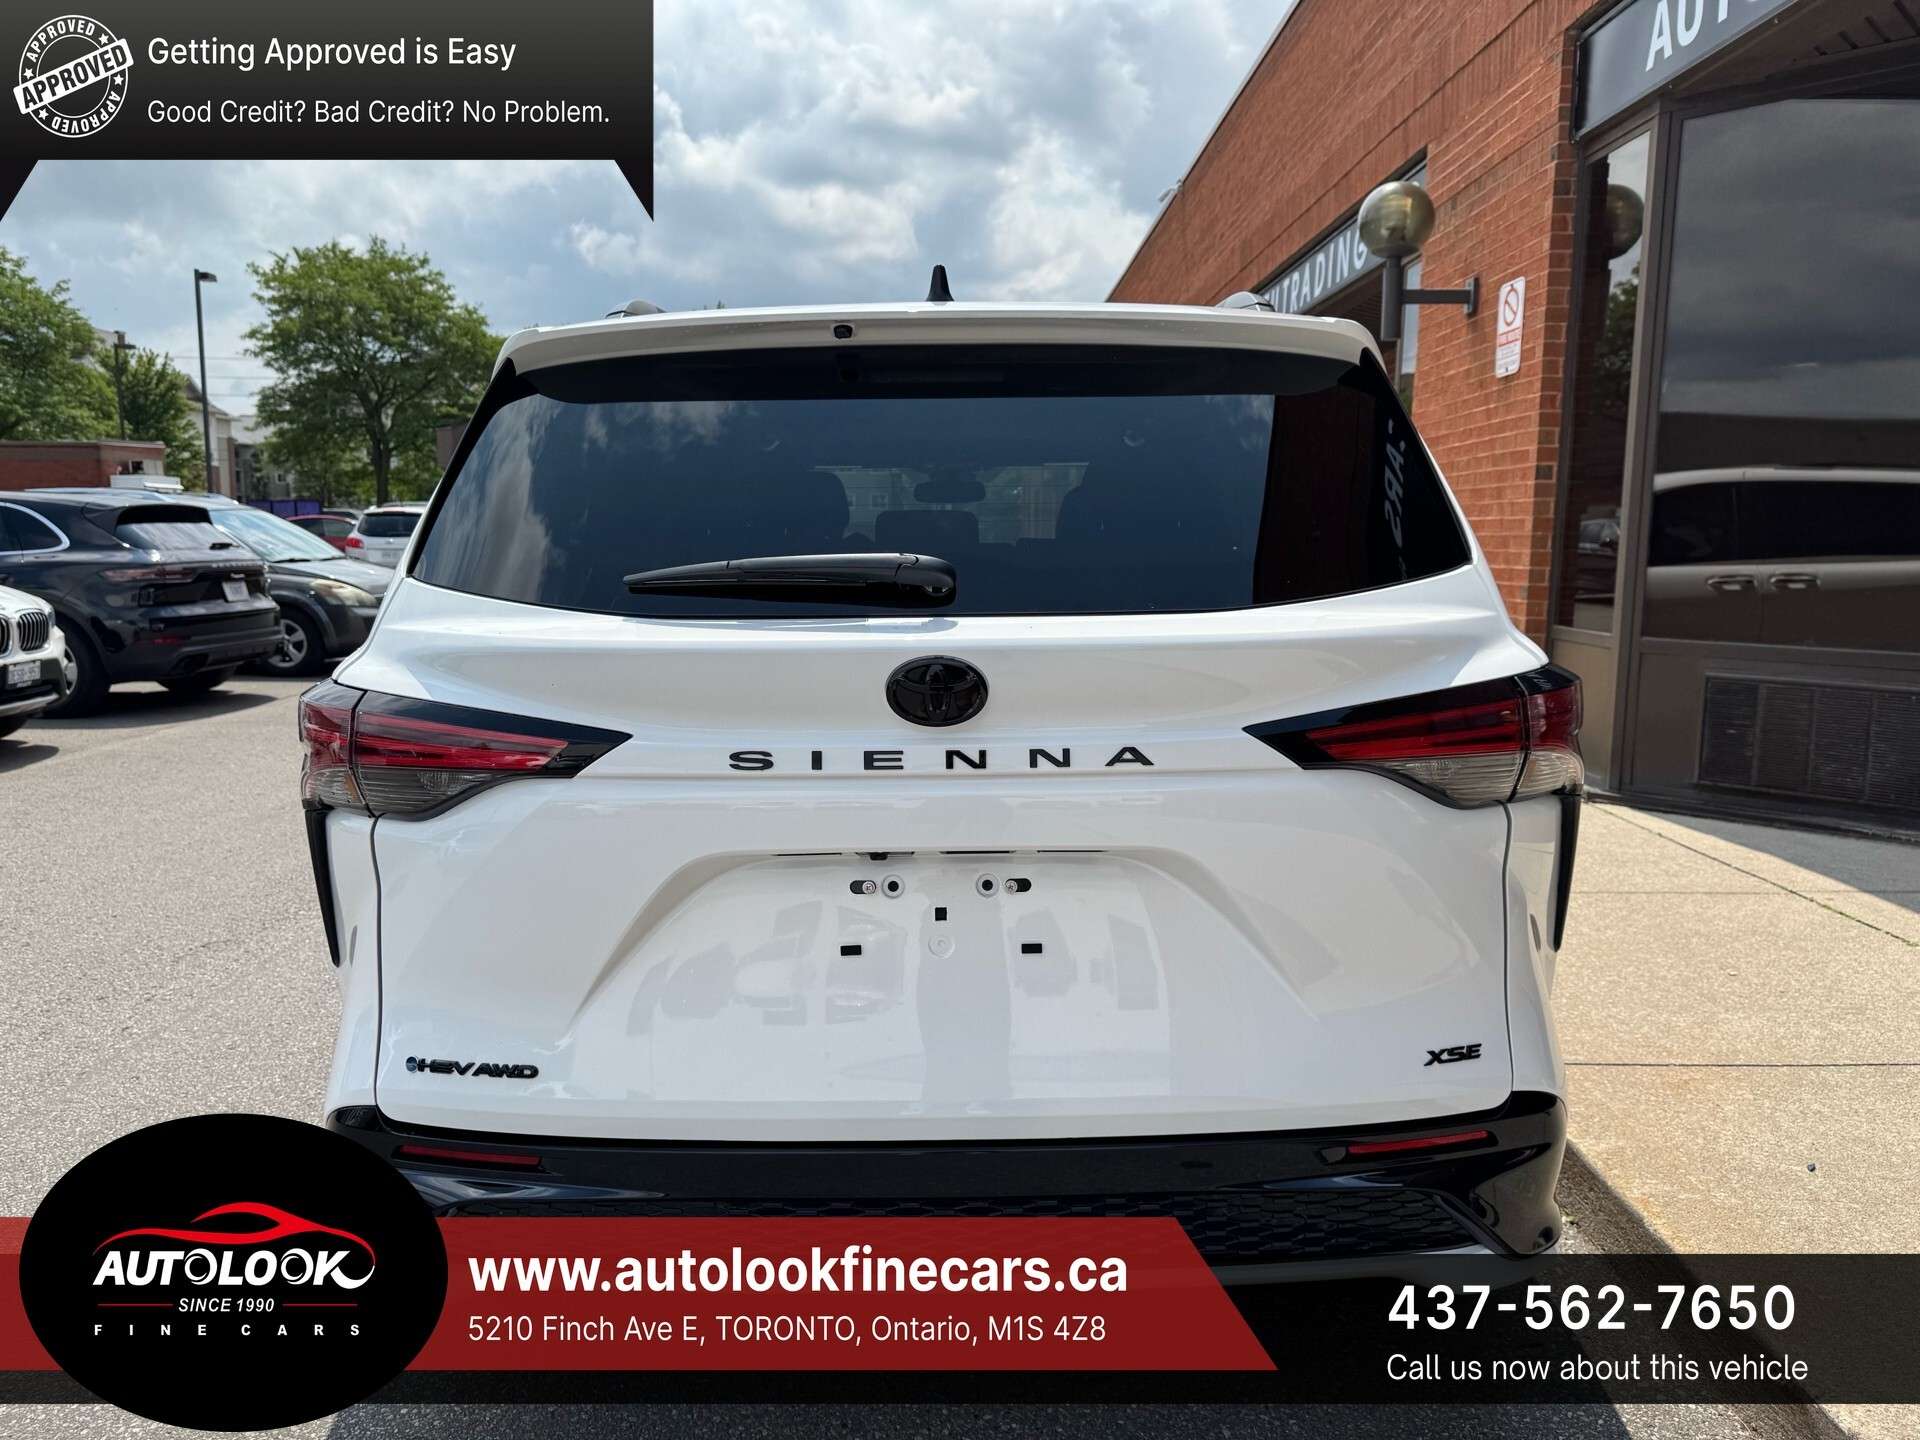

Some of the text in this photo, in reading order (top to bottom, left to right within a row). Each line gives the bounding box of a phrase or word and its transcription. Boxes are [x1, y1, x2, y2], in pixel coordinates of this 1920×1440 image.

[1645, 0, 1759, 72] AU
[1282, 226, 1368, 313] TRADING
[729, 746, 1154, 771] SIENNA
[1423, 1043, 1482, 1067] XSE
[472, 1062, 539, 1079] AWD
